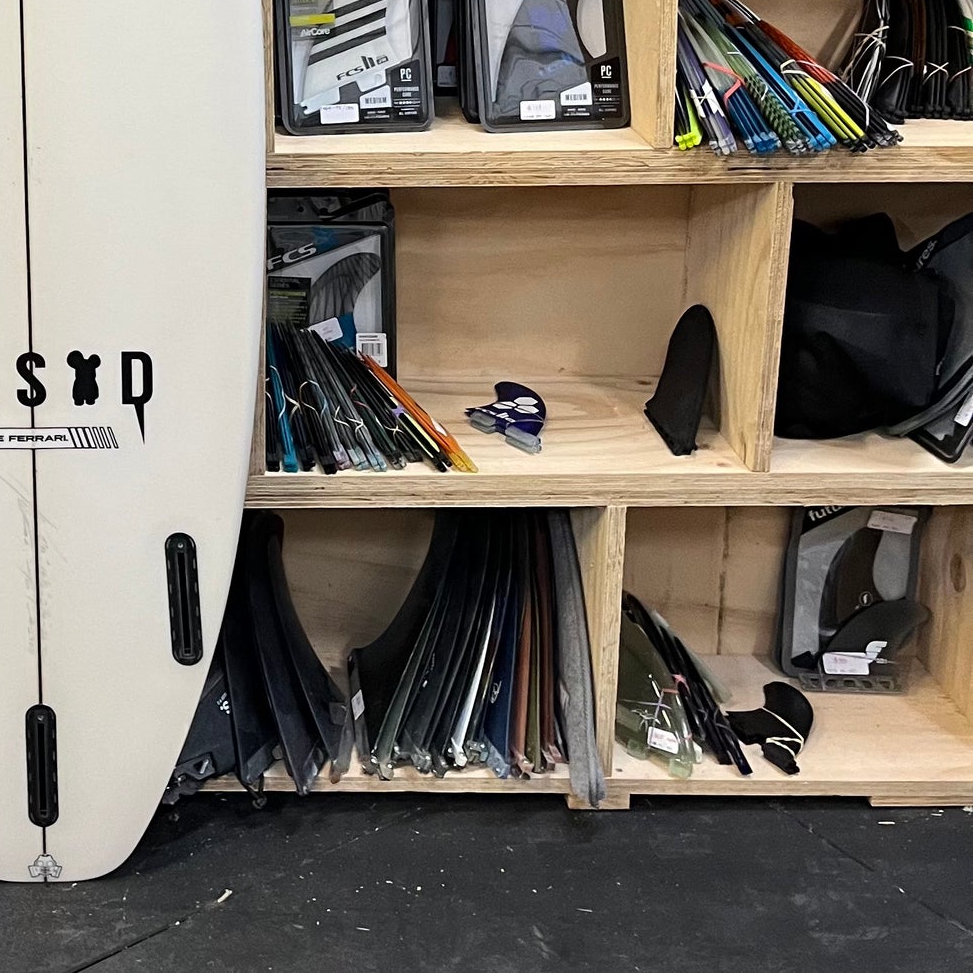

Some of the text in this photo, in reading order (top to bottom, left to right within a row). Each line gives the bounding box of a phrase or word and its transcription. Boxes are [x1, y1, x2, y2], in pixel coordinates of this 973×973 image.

[300, 28, 331, 38] AirCore
[336, 66, 364, 81] FCS
[400, 68, 412, 80] PC
[600, 65, 612, 76] PC
[364, 96, 387, 104] MEDIUM
[565, 93, 587, 101] MEDIUM
[267, 243, 317, 271] FCS
